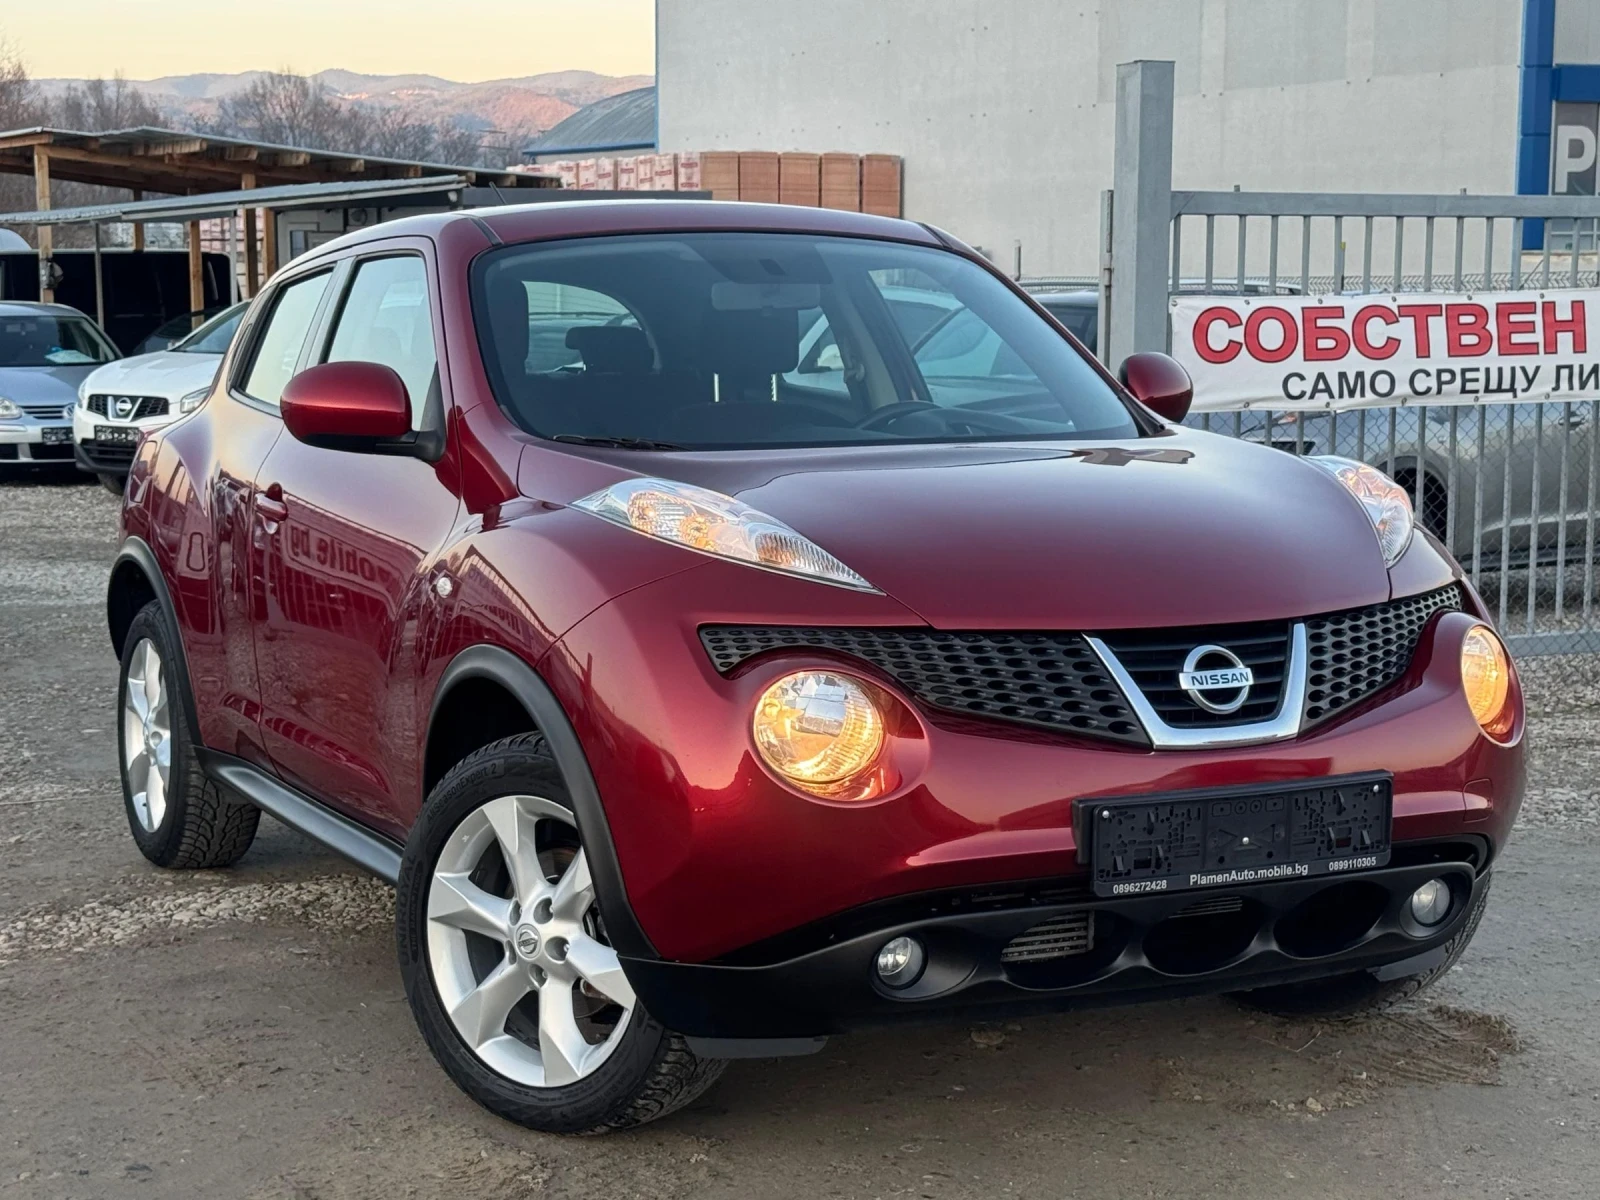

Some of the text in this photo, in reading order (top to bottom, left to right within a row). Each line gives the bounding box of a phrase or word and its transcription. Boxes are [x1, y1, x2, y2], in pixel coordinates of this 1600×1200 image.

[1554, 125, 1596, 193] P
[1192, 299, 1587, 364] СОБСТВЕН
[1281, 363, 1599, 400] САМО СРЕЩУ ЛИ
[1190, 671, 1250, 687] NISSAN
[426, 763, 497, 824] AllSeasonExpert 2
[1112, 856, 1377, 894] 0896272428 PlamenAuto.mobile.bg 0899110305
[399, 852, 416, 966] UNIROYAL
